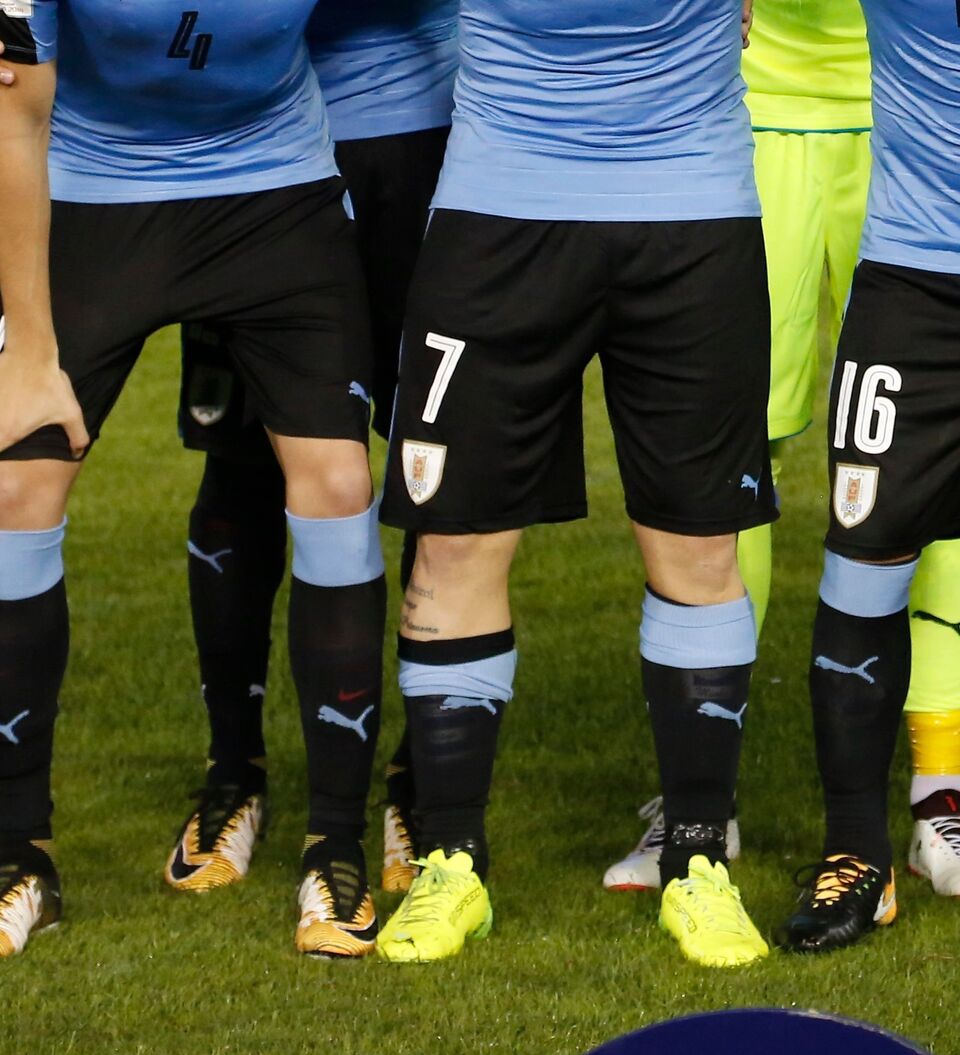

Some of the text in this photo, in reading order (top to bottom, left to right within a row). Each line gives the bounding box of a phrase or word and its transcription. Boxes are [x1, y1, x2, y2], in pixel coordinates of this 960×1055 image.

[167, 10, 212, 71] 4
[421, 331, 466, 424] 7
[832, 360, 902, 455] 16
